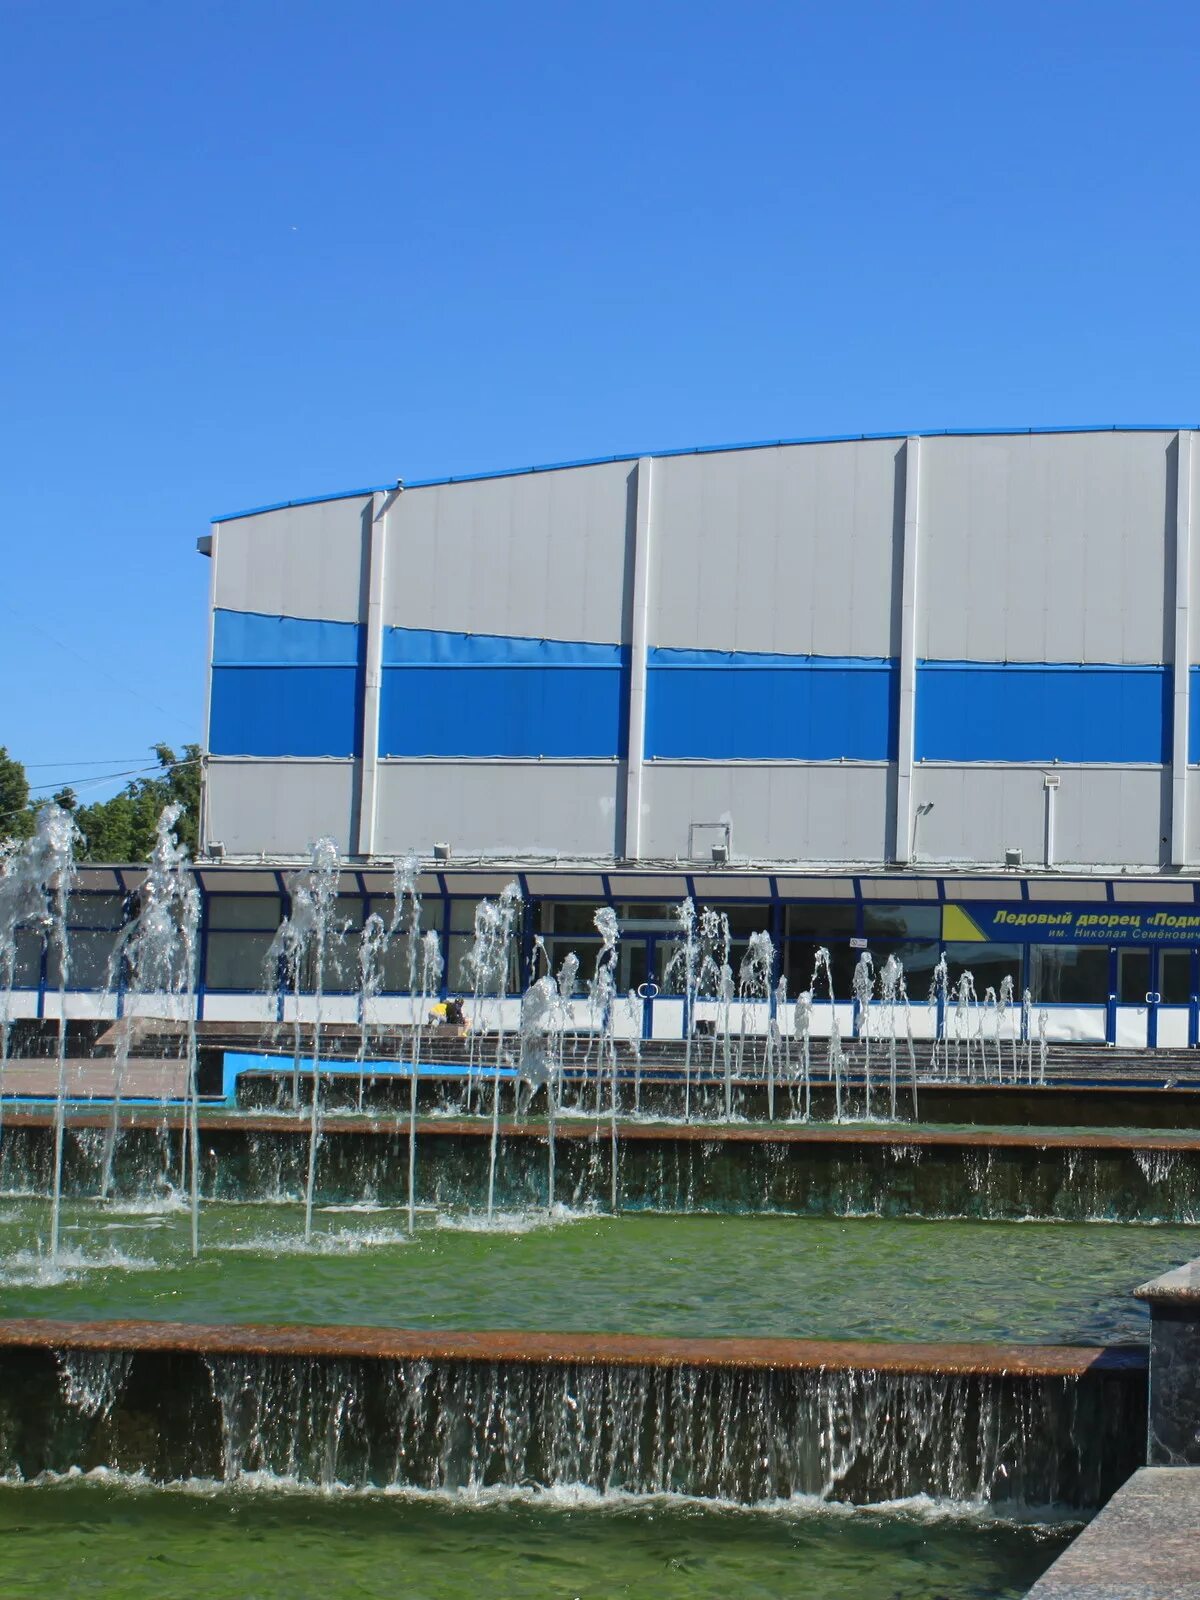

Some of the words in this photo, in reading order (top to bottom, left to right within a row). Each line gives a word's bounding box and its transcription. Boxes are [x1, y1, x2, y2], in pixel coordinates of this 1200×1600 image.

[993, 910, 1073, 926] Ледовый
[1076, 913, 1141, 927] дворец
[1048, 929, 1069, 938] им.
[1074, 928, 1128, 939] Николая
